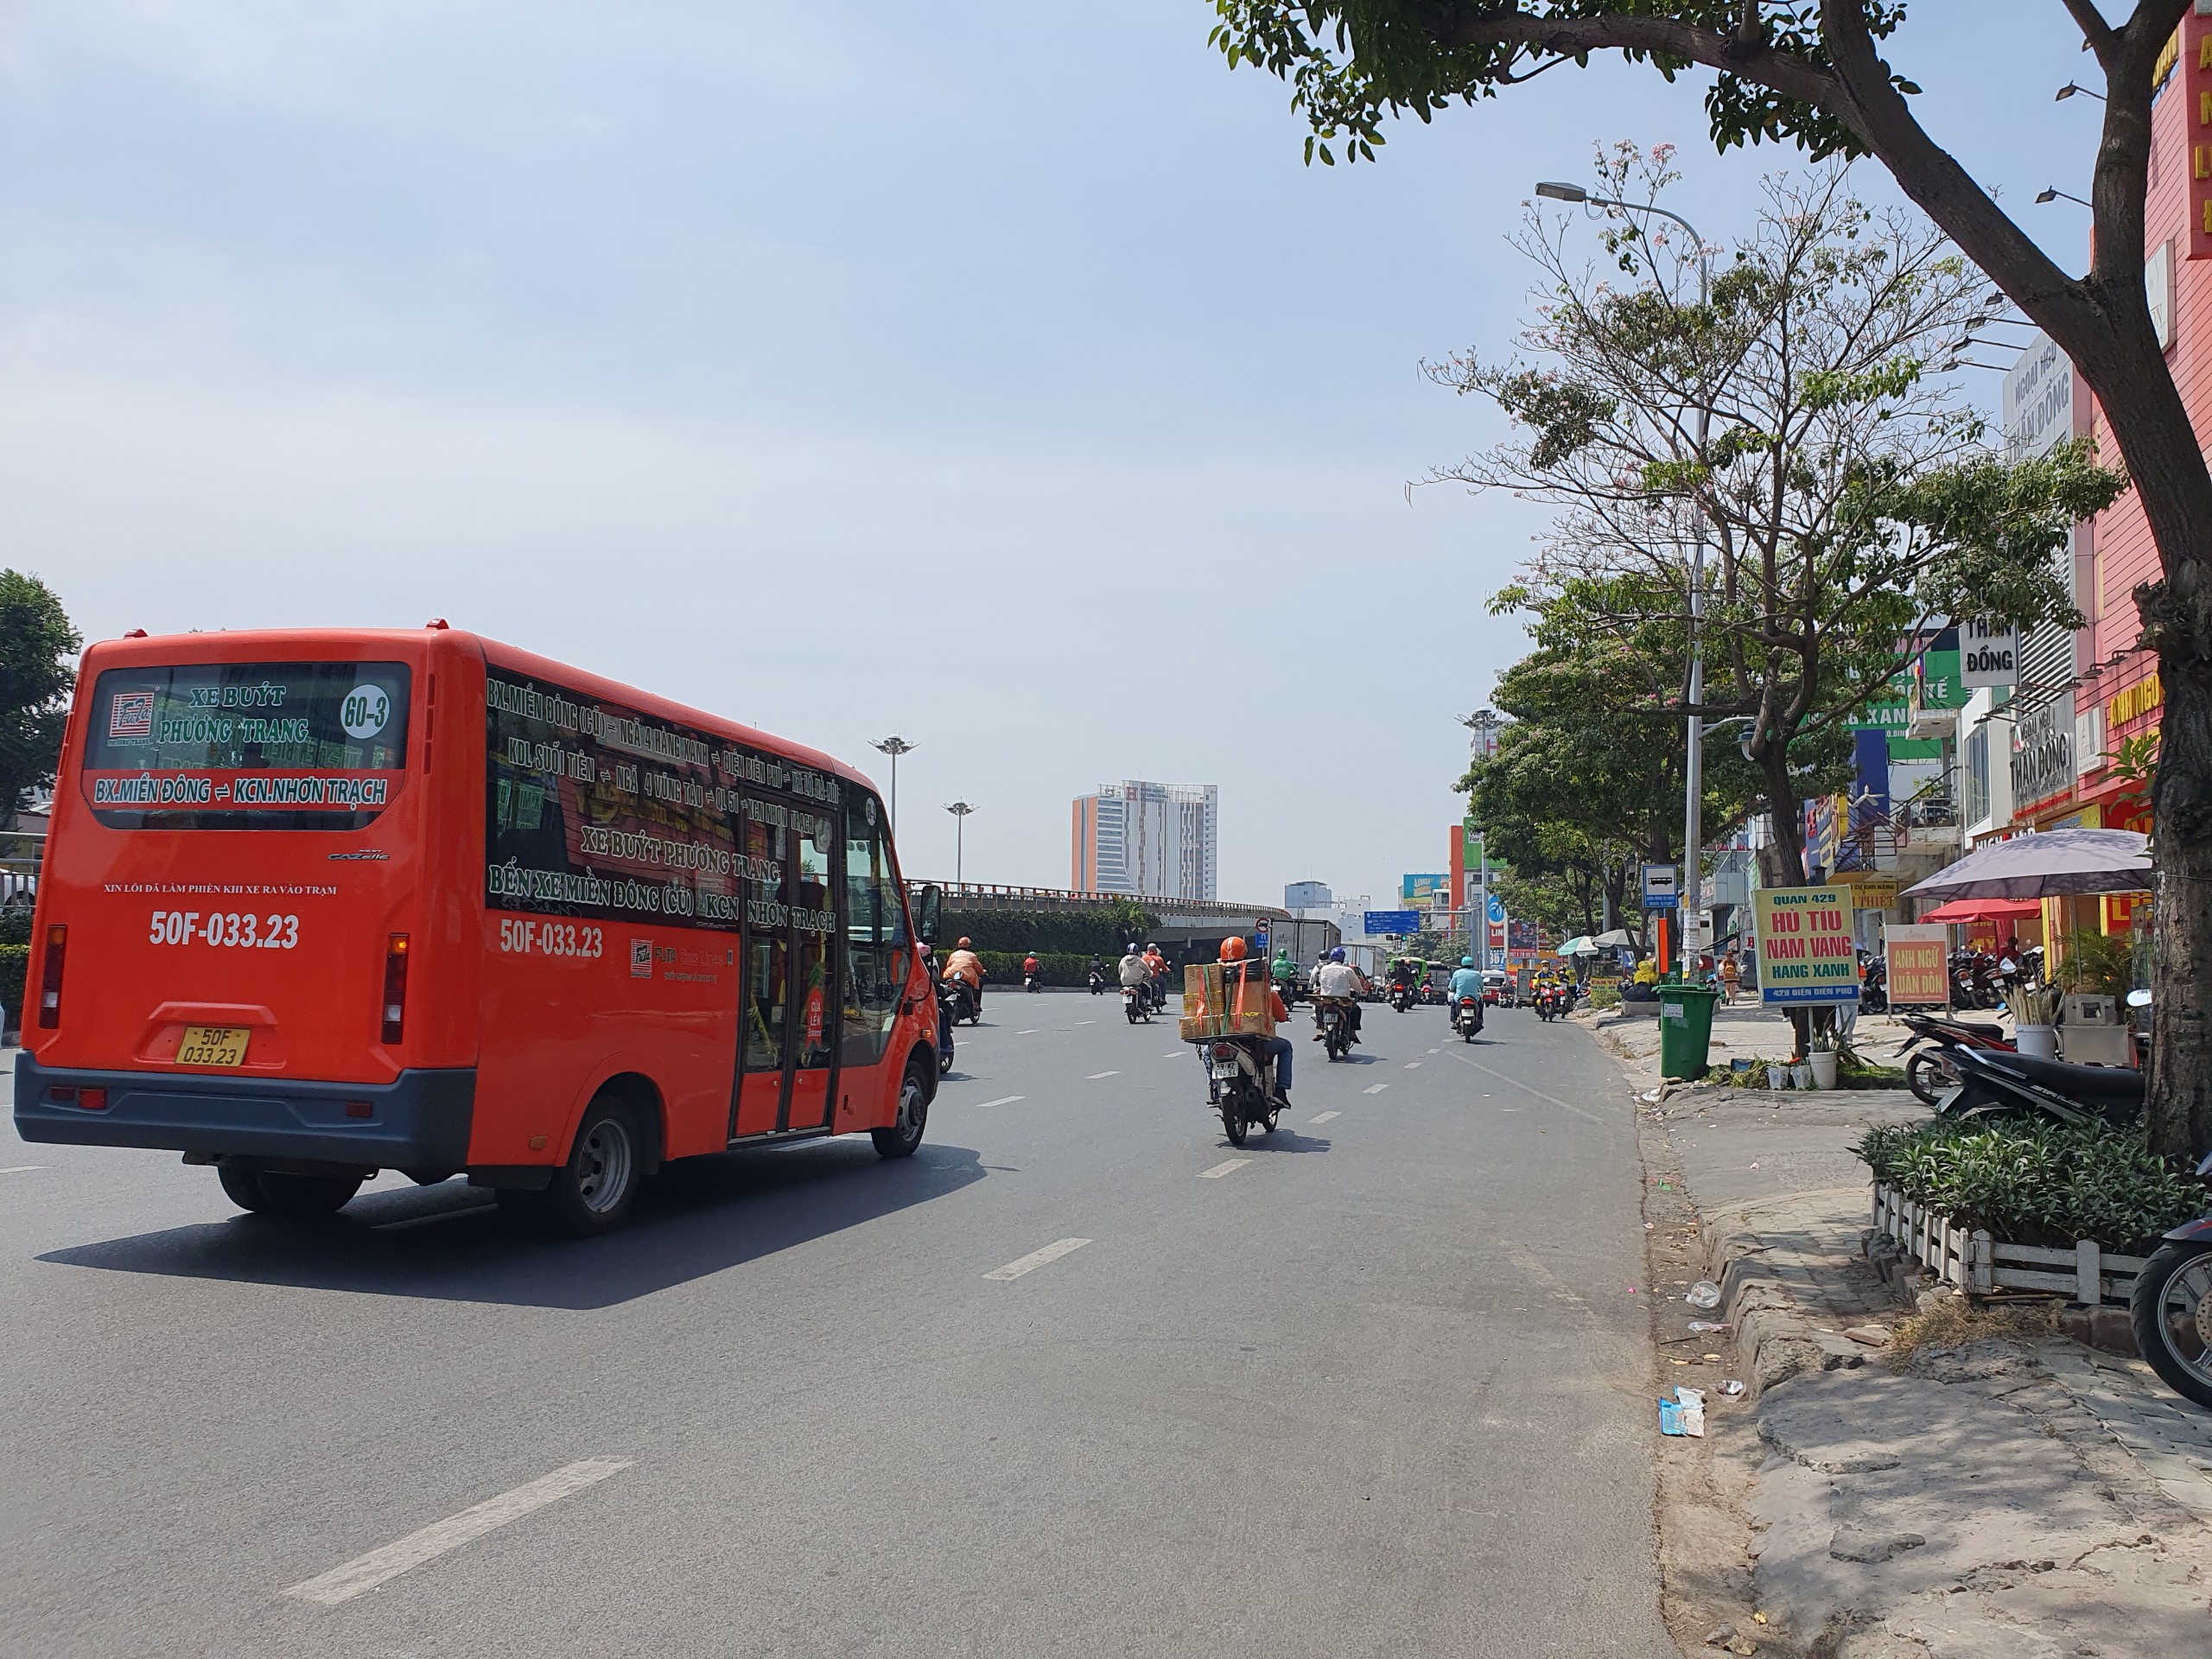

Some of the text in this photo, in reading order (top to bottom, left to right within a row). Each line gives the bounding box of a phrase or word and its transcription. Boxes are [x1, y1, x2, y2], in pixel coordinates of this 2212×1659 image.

[2037, 372, 2069, 436] ĐỒNG
[1967, 613, 2012, 638] THN
[1967, 644, 2013, 672] ĐỒNG
[190, 681, 286, 707] XE BUÝT
[2110, 688, 2135, 728] ANH
[344, 696, 387, 728] 60-3
[158, 713, 309, 744] PHƯƠNG TRANG
[545, 694, 578, 731] ĐÔNG
[620, 719, 642, 749] NGÃ
[645, 726, 652, 750] 4
[655, 726, 682, 760] HÀNG
[683, 737, 709, 767] XANH
[746, 755, 765, 784] BIÊN
[162, 774, 210, 803] ĐÔNG
[328, 779, 387, 810] TRẠCH
[508, 737, 532, 767] KDL
[568, 749, 595, 783] TIÊN
[616, 765, 638, 794] NGÃ
[645, 772, 652, 796] 4
[683, 779, 703, 808] TÀU
[715, 787, 728, 812] QL
[728, 791, 739, 813] 51
[747, 798, 765, 822] KCN
[582, 826, 779, 882] XE BUÝT PHƯƠNG TRANG
[104, 884, 122, 893] XIN
[224, 885, 244, 893] KHI
[246, 885, 260, 894] XE
[263, 886, 277, 894] RA
[305, 886, 337, 897] TRẠM
[535, 871, 563, 901] XE
[613, 879, 659, 912] ĐÔNG
[705, 893, 739, 921] KCN
[791, 905, 836, 938] TRẠCH
[1812, 893, 1836, 903] 429
[149, 912, 299, 949] 50F-033.23
[1771, 907, 1800, 933] HỦ
[500, 919, 603, 958] 50F-033.23
[1766, 936, 1853, 959] NAM VANG
[1813, 963, 1849, 977] XANH
[1895, 945, 1939, 969] ANH NGỮ
[1893, 970, 1942, 994] LUÂN ĐÔN
[201, 1029, 232, 1046] 50F
[183, 1047, 237, 1065] 033.23
